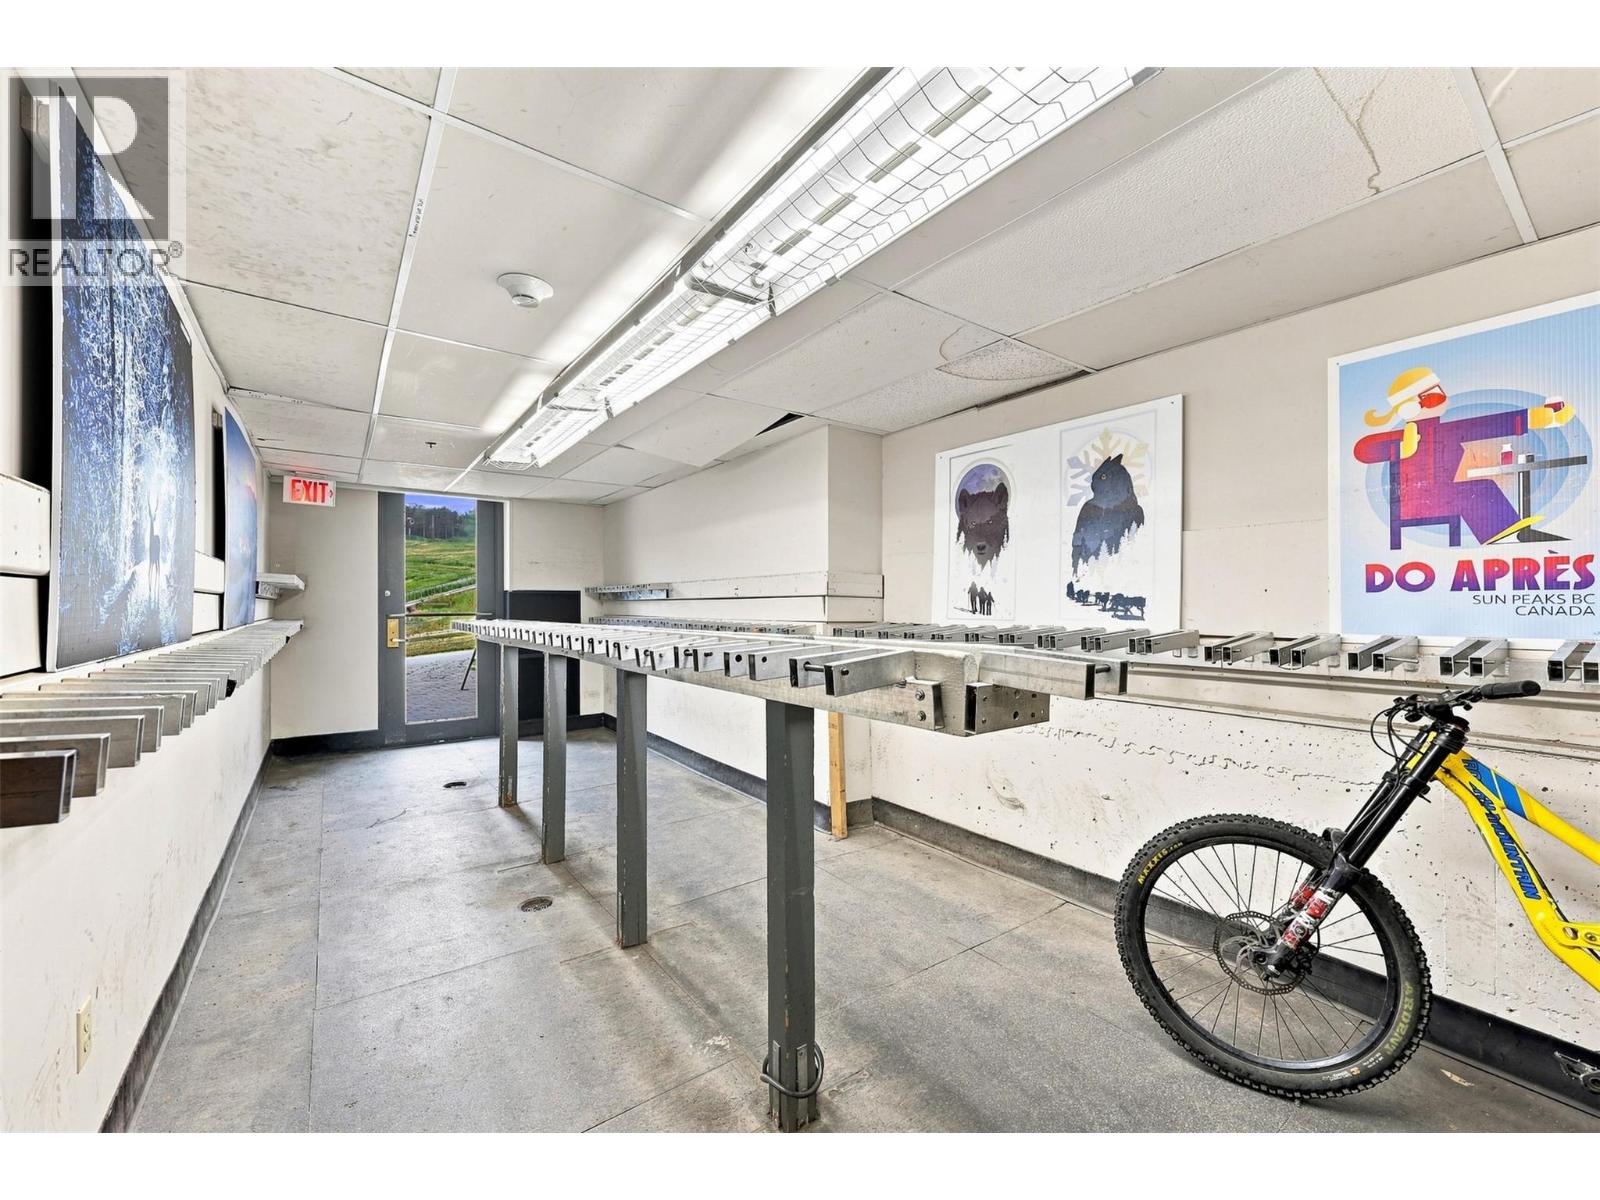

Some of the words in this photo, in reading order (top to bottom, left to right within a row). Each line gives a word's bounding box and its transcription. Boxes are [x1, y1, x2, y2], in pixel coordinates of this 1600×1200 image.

[291, 479, 328, 503] EXIT
[1366, 561, 1436, 593] DO
[1450, 549, 1595, 592] APRÈS
[1472, 594, 1507, 605] SUN
[1512, 594, 1566, 605] PEAKS
[1572, 593, 1596, 605] BC
[1515, 605, 1596, 616] CANADA
